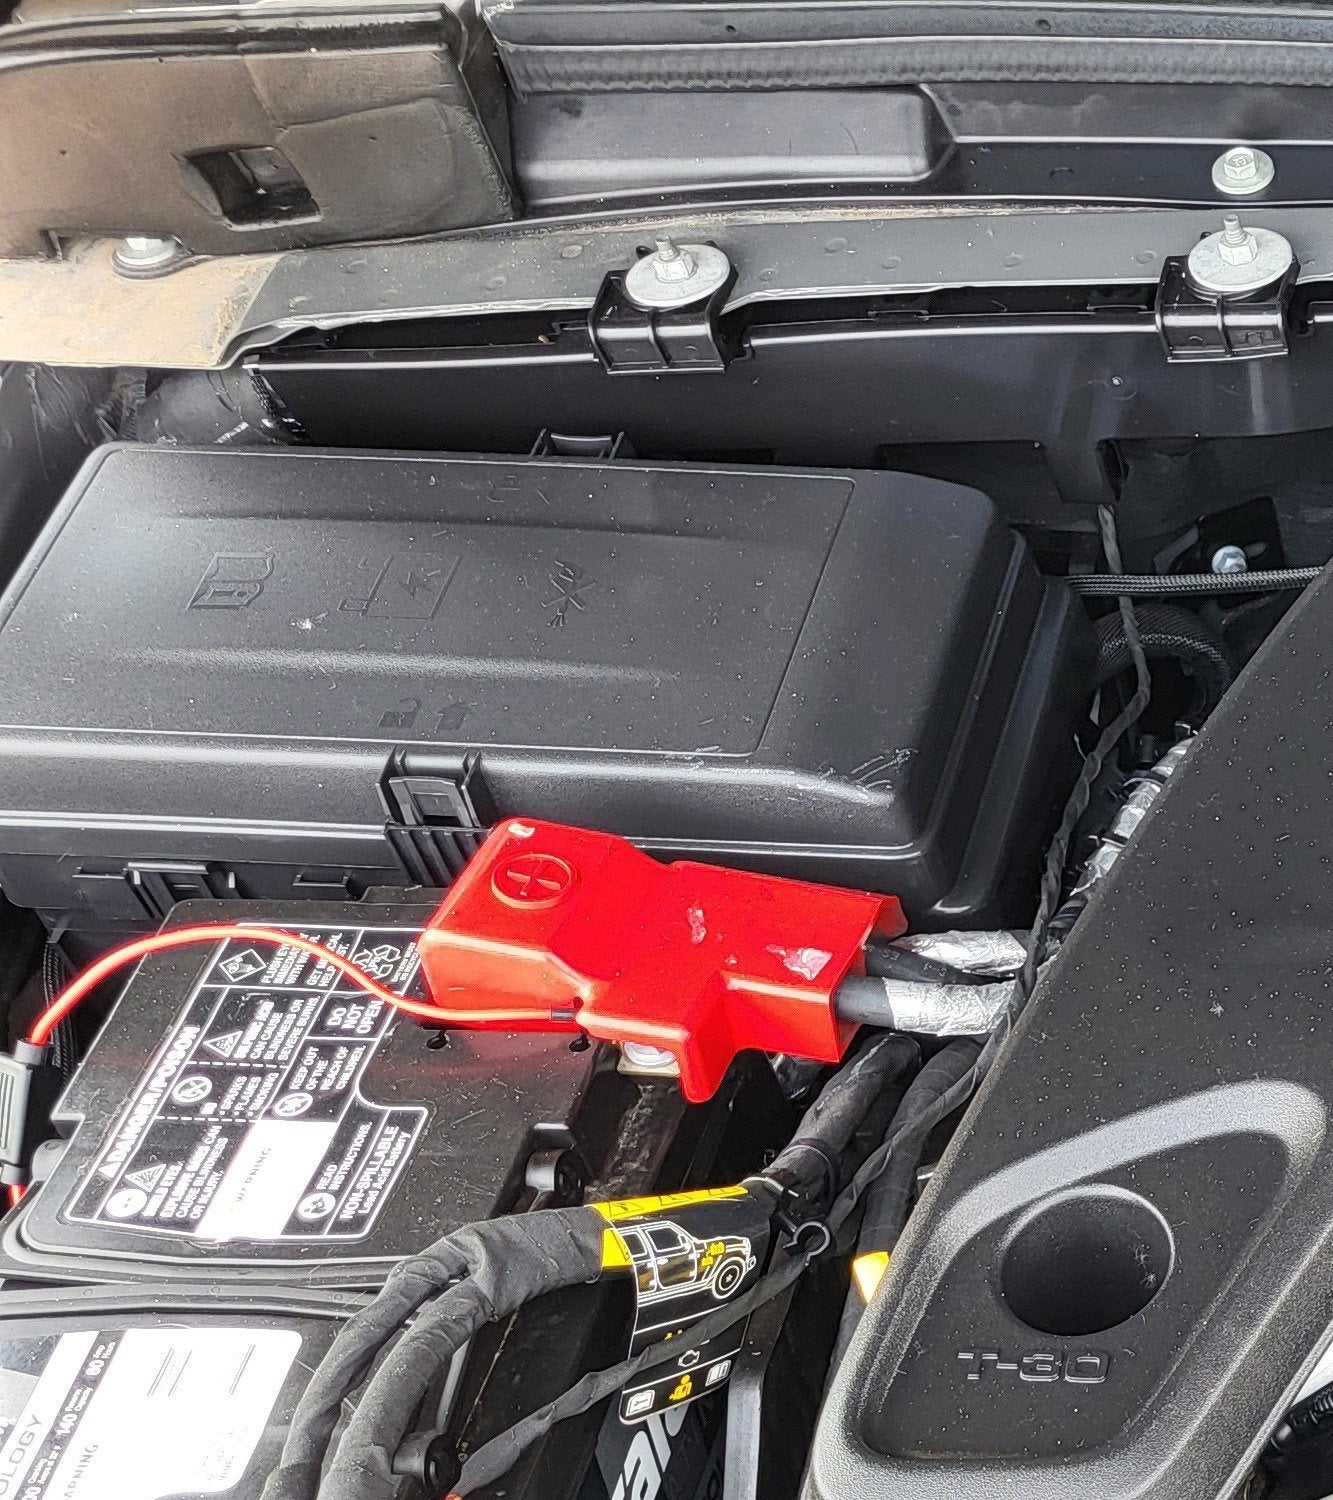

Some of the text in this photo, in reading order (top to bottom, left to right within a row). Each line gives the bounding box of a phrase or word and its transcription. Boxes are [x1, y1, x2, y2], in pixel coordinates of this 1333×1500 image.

[325, 1007, 348, 1025] DO
[340, 1003, 367, 1028] NOT
[354, 999, 386, 1033] OPEN
[339, 1125, 400, 1219] NON-SPILLABLE
[371, 1167, 392, 1189] Acid
[382, 1130, 414, 1166] Battery
[314, 1164, 338, 1189] READ
[957, 1350, 1109, 1383] T-30
[53, 1413, 79, 1434] 140
